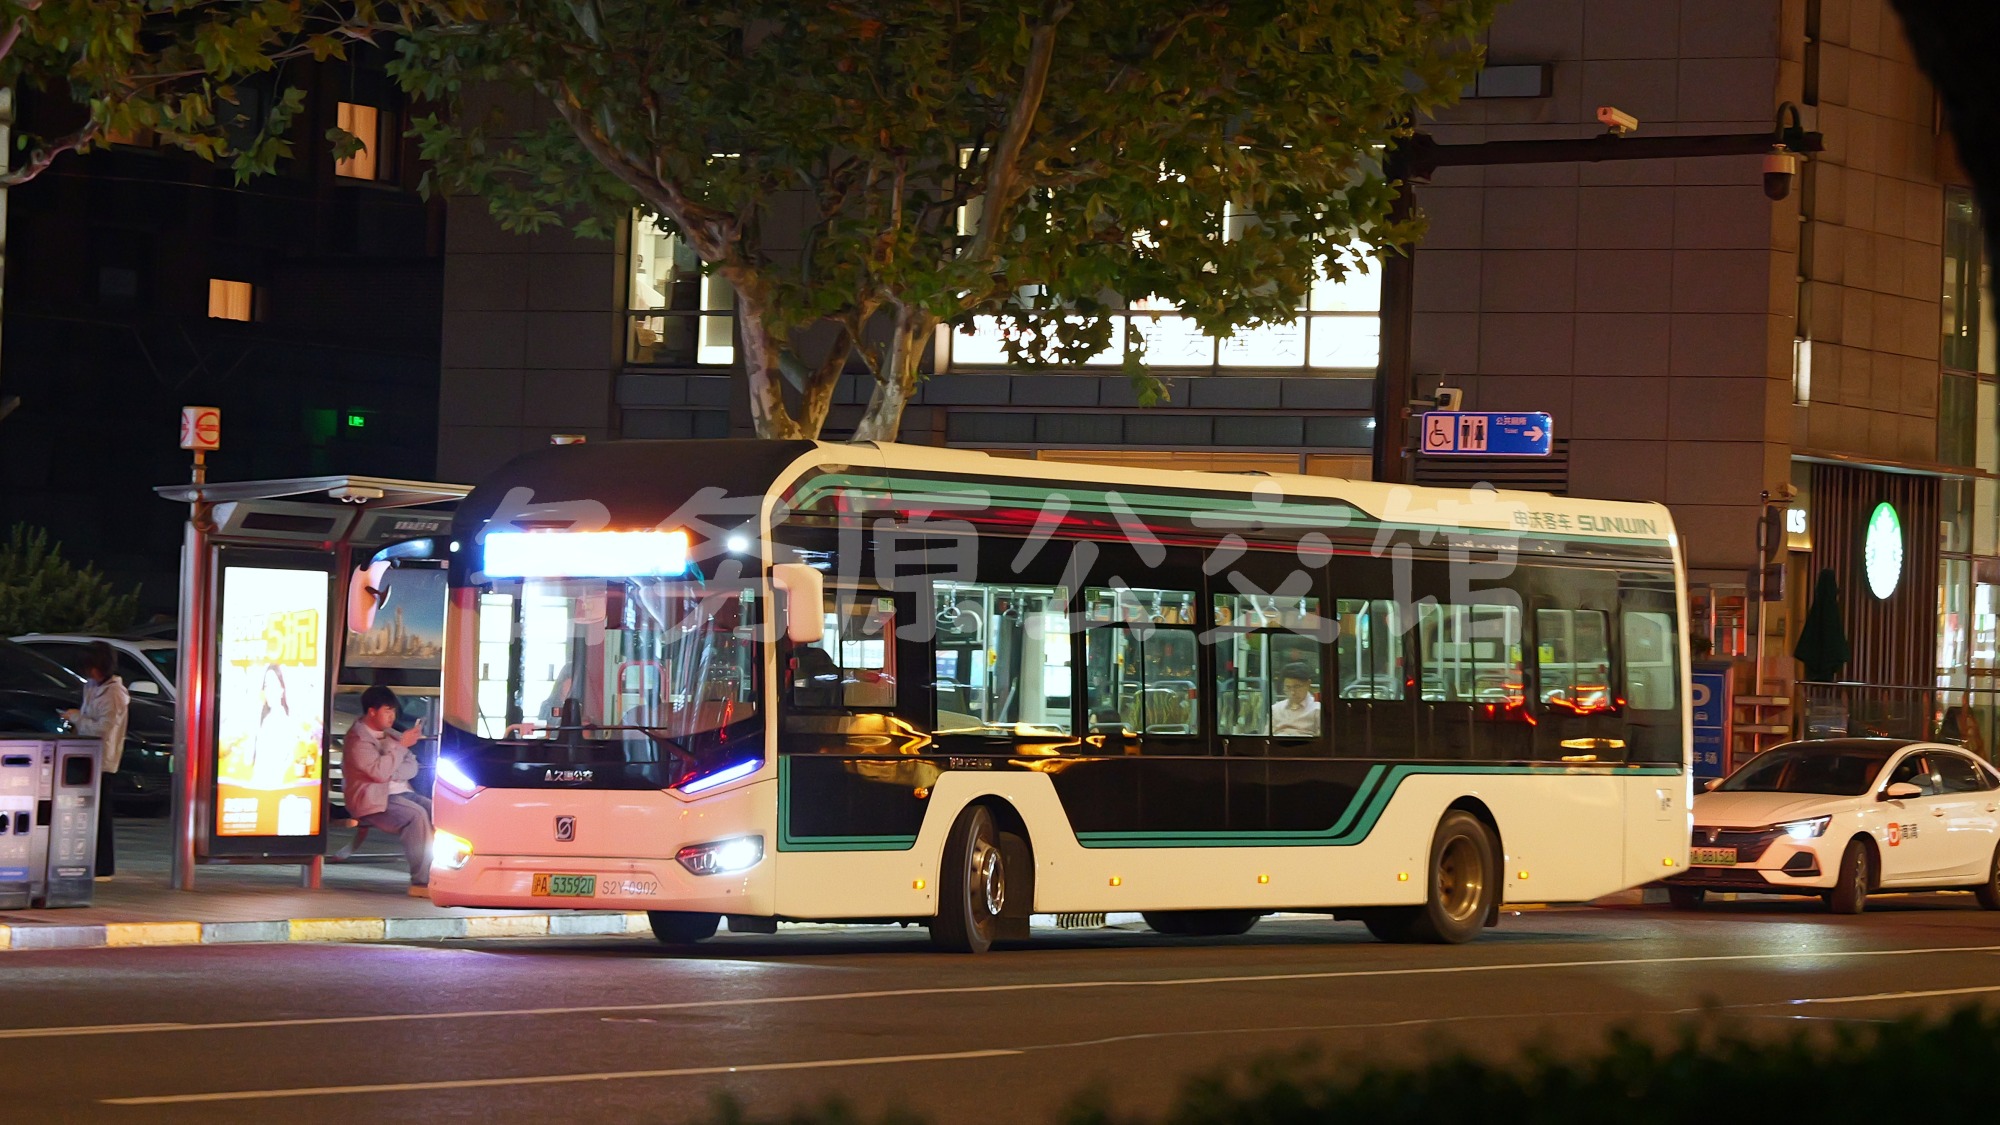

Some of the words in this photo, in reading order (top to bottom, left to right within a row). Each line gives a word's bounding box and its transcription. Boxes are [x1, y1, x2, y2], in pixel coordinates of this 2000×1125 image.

[1513, 510, 1573, 530] 申沃客车
[1577, 514, 1658, 535] SUNWIN
[602, 880, 658, 896] S2Y-0902
